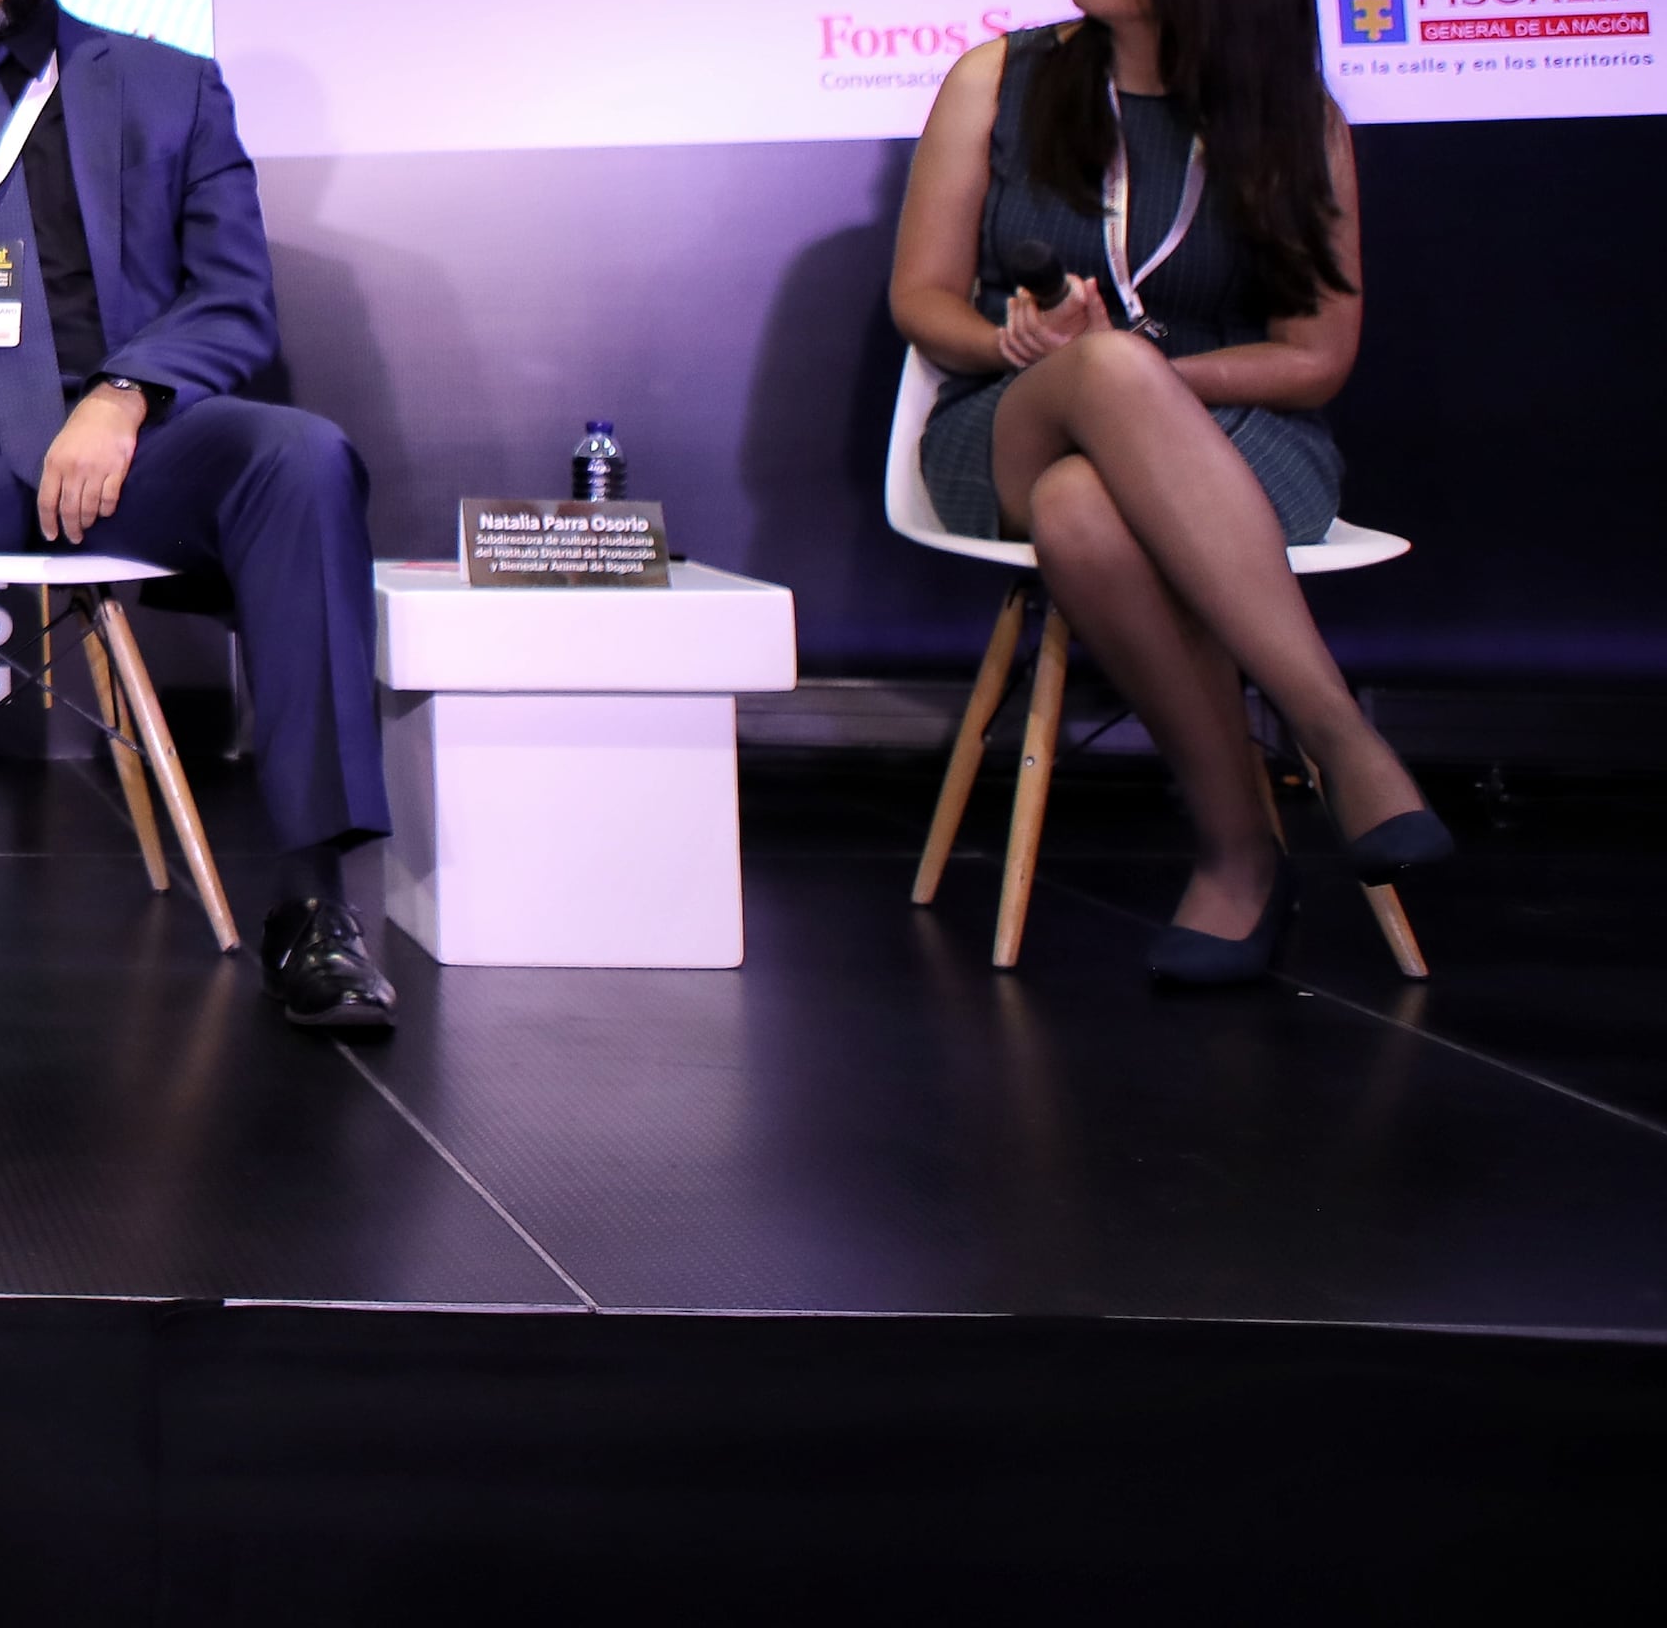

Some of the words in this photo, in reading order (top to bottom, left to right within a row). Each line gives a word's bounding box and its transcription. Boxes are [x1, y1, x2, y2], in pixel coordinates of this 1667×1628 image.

[1425, 23, 1511, 40] GENERAL
[1516, 22, 1539, 37] DE
[1545, 20, 1571, 35] LA
[1571, 14, 1645, 34] NACIÓN
[819, 14, 969, 60] Foros
[1339, 62, 1363, 76] En
[1370, 60, 1389, 74] la
[1397, 58, 1446, 73] calle
[1455, 62, 1466, 75] y
[1473, 58, 1497, 71] en
[1505, 55, 1536, 70] los
[1544, 52, 1654, 69] territorios
[480, 515, 540, 531] Natalia
[544, 517, 588, 531] Parra
[591, 517, 649, 532] Osorio
[476, 535, 542, 545] Subdirectora
[545, 535, 558, 545] de
[561, 536, 597, 546] cultura
[600, 536, 653, 546] ciudadana
[475, 548, 492, 558] del
[495, 548, 539, 558] Instituto
[541, 548, 581, 558] Distrital
[584, 549, 598, 559] de
[600, 548, 656, 560] Protección
[499, 561, 548, 571] Bienestar
[551, 562, 588, 572] Animal
[591, 562, 604, 572] de
